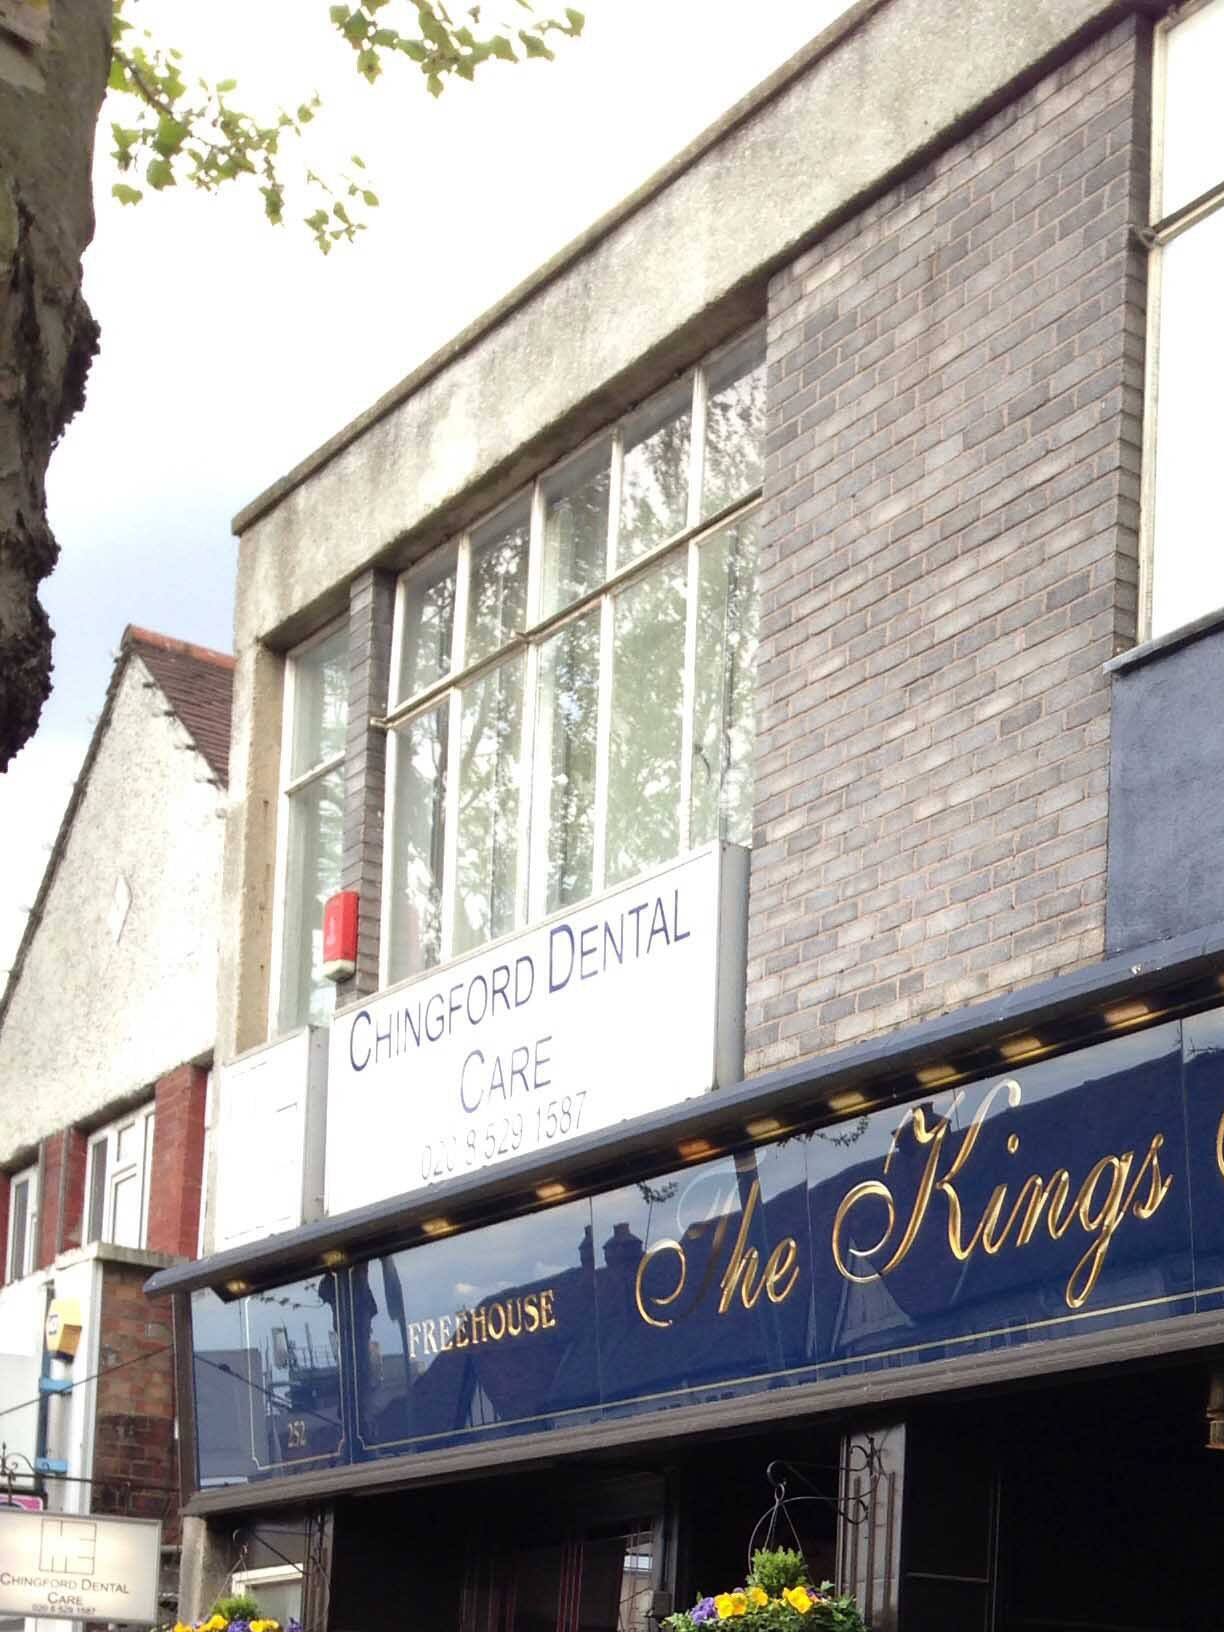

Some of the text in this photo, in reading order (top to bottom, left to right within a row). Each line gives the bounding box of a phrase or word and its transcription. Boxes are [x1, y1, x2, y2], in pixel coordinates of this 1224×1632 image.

[350, 889, 691, 1072] CHINGFORD DENTAL
[460, 1035, 554, 1114] CARE
[483, 1113, 524, 1160] 529
[535, 1090, 588, 1143] 1587
[635, 1150, 800, 1327] The
[832, 1077, 1174, 1309] Kings
[408, 1288, 557, 1359] FREEHOUSE
[0, 1572, 129, 1594] CHINGFORD DENTAL
[48, 1592, 82, 1605] CARE
